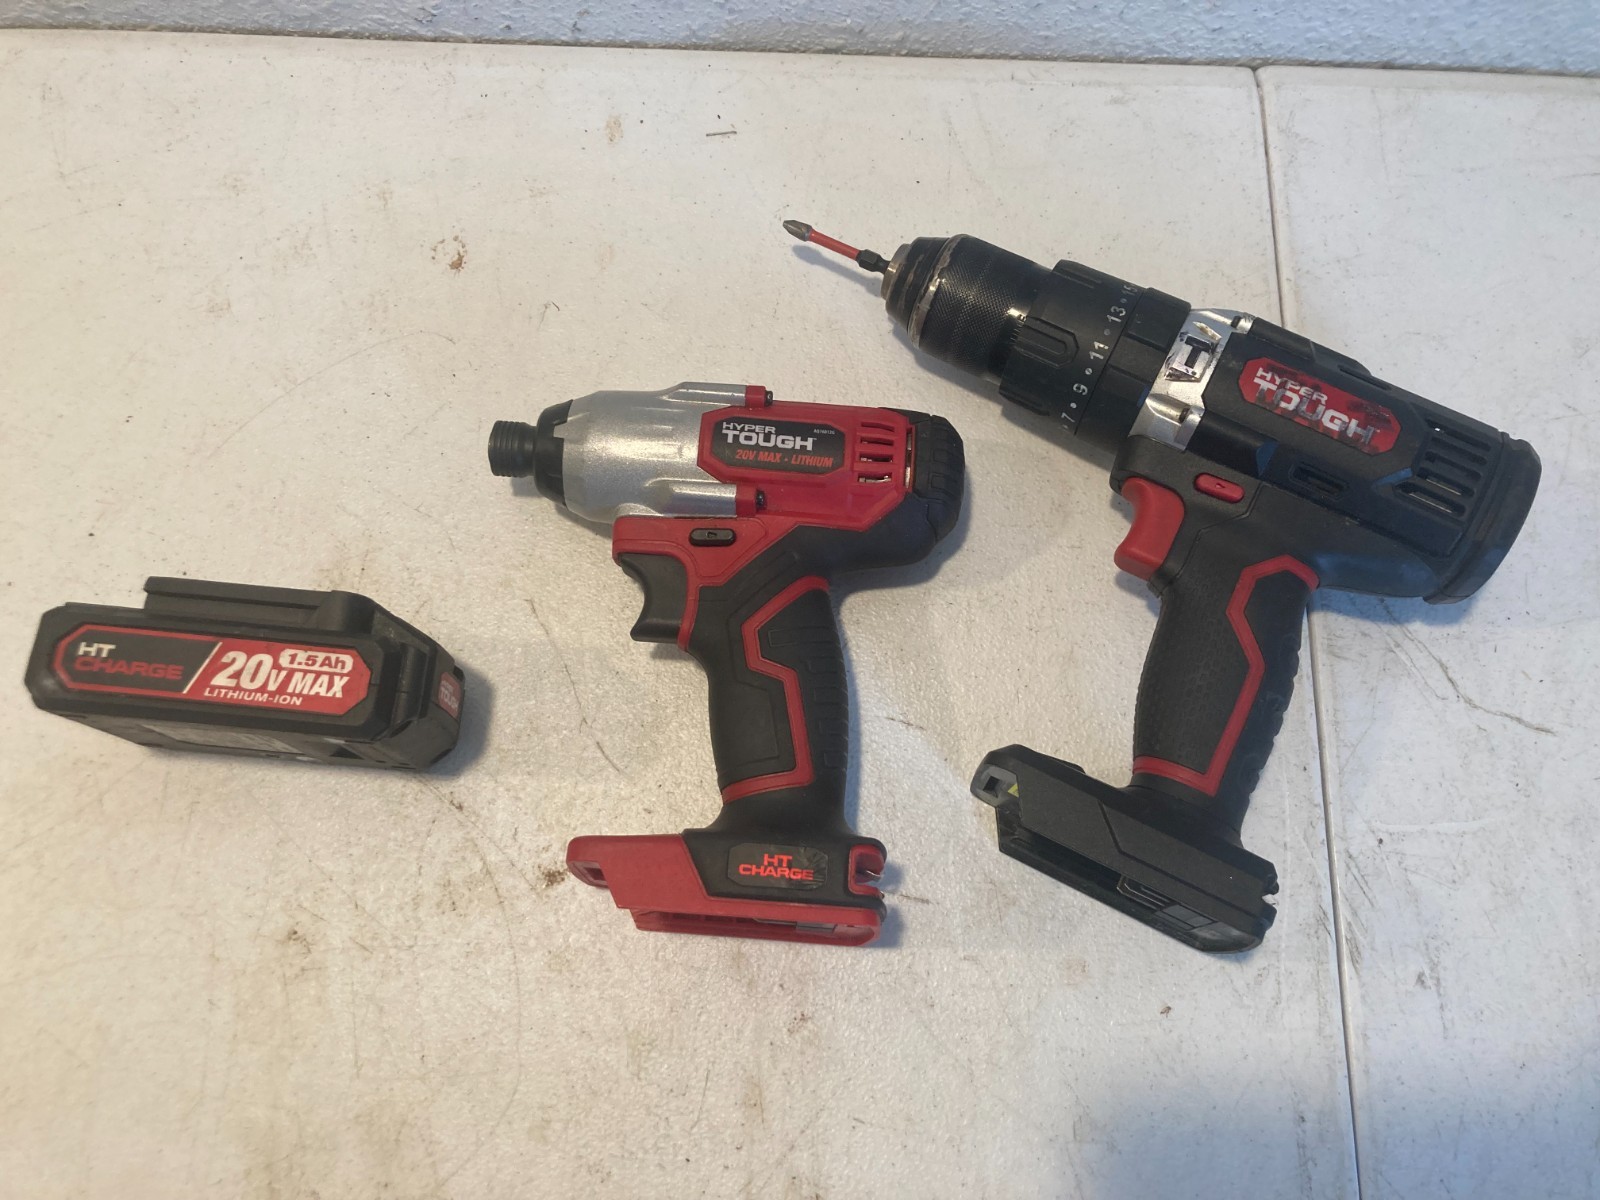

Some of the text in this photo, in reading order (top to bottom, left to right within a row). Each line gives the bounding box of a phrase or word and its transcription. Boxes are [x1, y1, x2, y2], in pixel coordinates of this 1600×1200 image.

[1072, 383, 1089, 396] 9
[1088, 341, 1110, 361] 11
[1106, 305, 1127, 323] 13
[1254, 366, 1329, 406] HYPER
[1252, 376, 1376, 446] TOUGH
[722, 421, 777, 434] HYPER
[721, 429, 814, 452] TOUGH
[735, 448, 835, 468] 20V MAX LITHIUM
[77, 641, 117, 658] HT
[73, 656, 185, 681] CHARGE
[203, 686, 303, 706] LITHIUM-ION
[286, 672, 350, 699] MAX
[762, 852, 793, 868] HT
[738, 862, 815, 881] CHARGE
